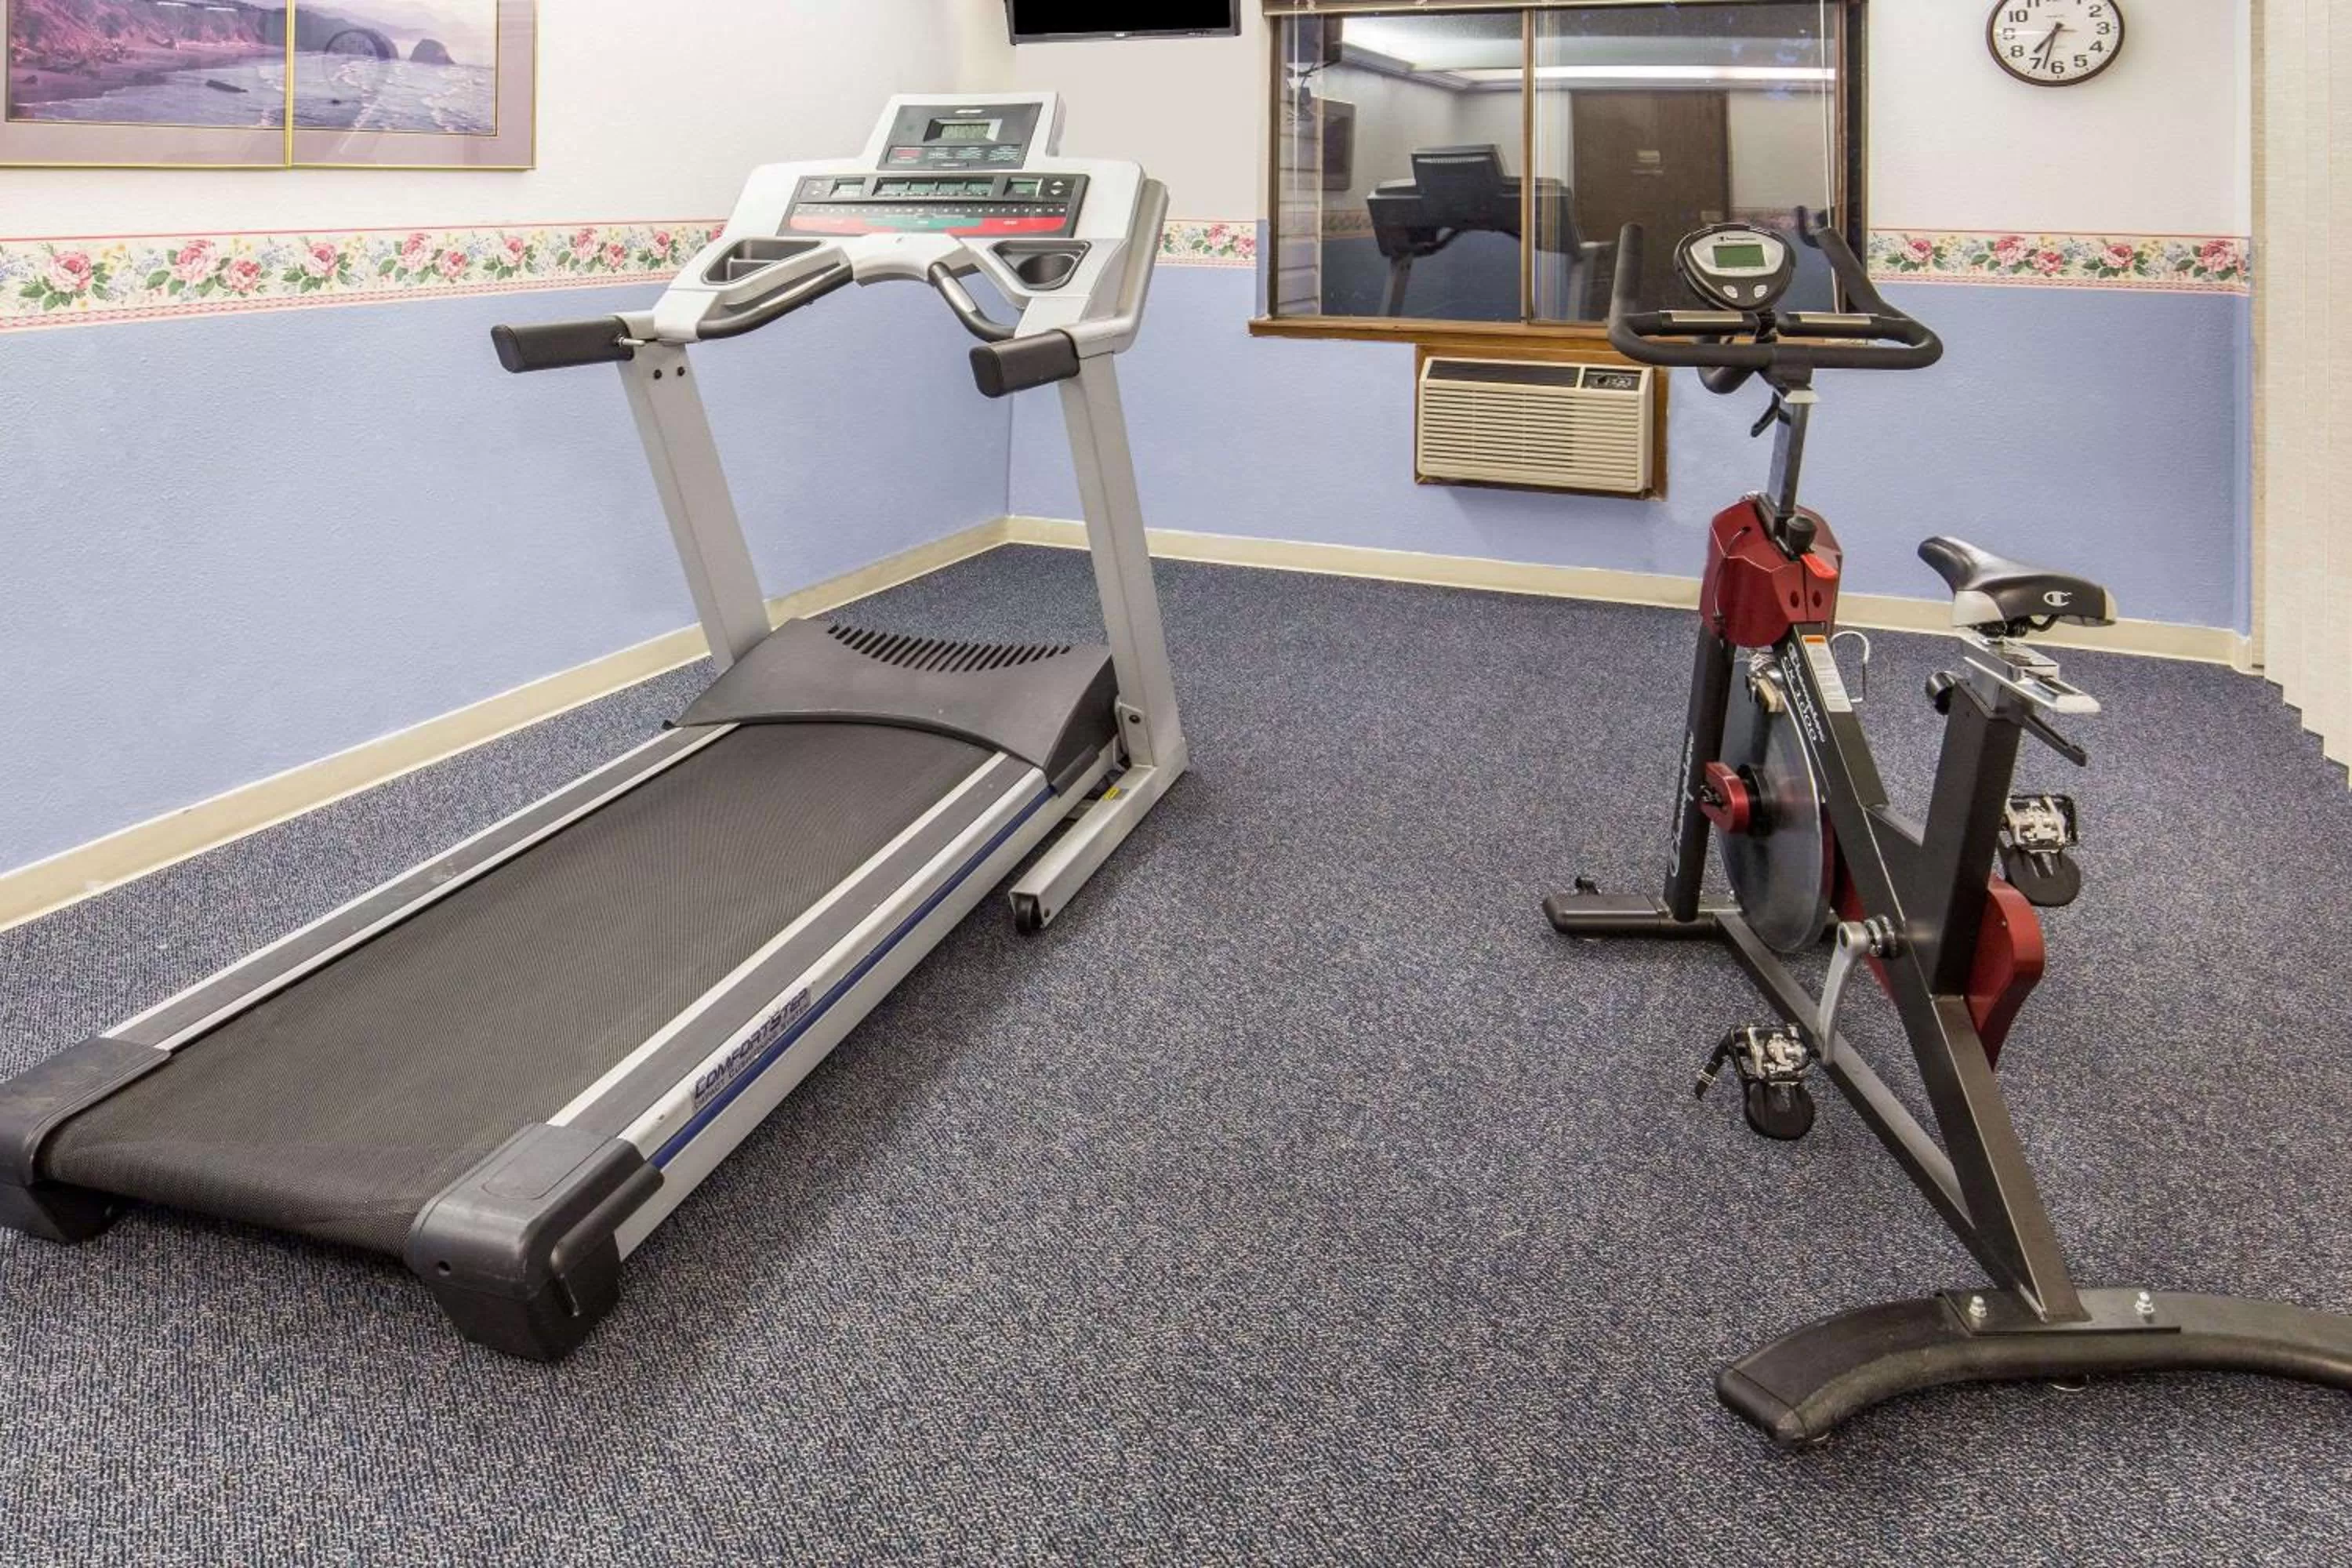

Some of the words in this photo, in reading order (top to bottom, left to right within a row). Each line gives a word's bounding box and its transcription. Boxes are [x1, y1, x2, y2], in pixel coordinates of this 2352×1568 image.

[2009, 9, 2028, 22] 10
[2089, 5, 2102, 17] 2
[2096, 22, 2110, 34] 3
[2010, 45, 2024, 57] 8
[2089, 40, 2103, 53] 4
[2029, 57, 2042, 69] 7
[2074, 55, 2087, 67] 5
[2051, 61, 2064, 74] 6
